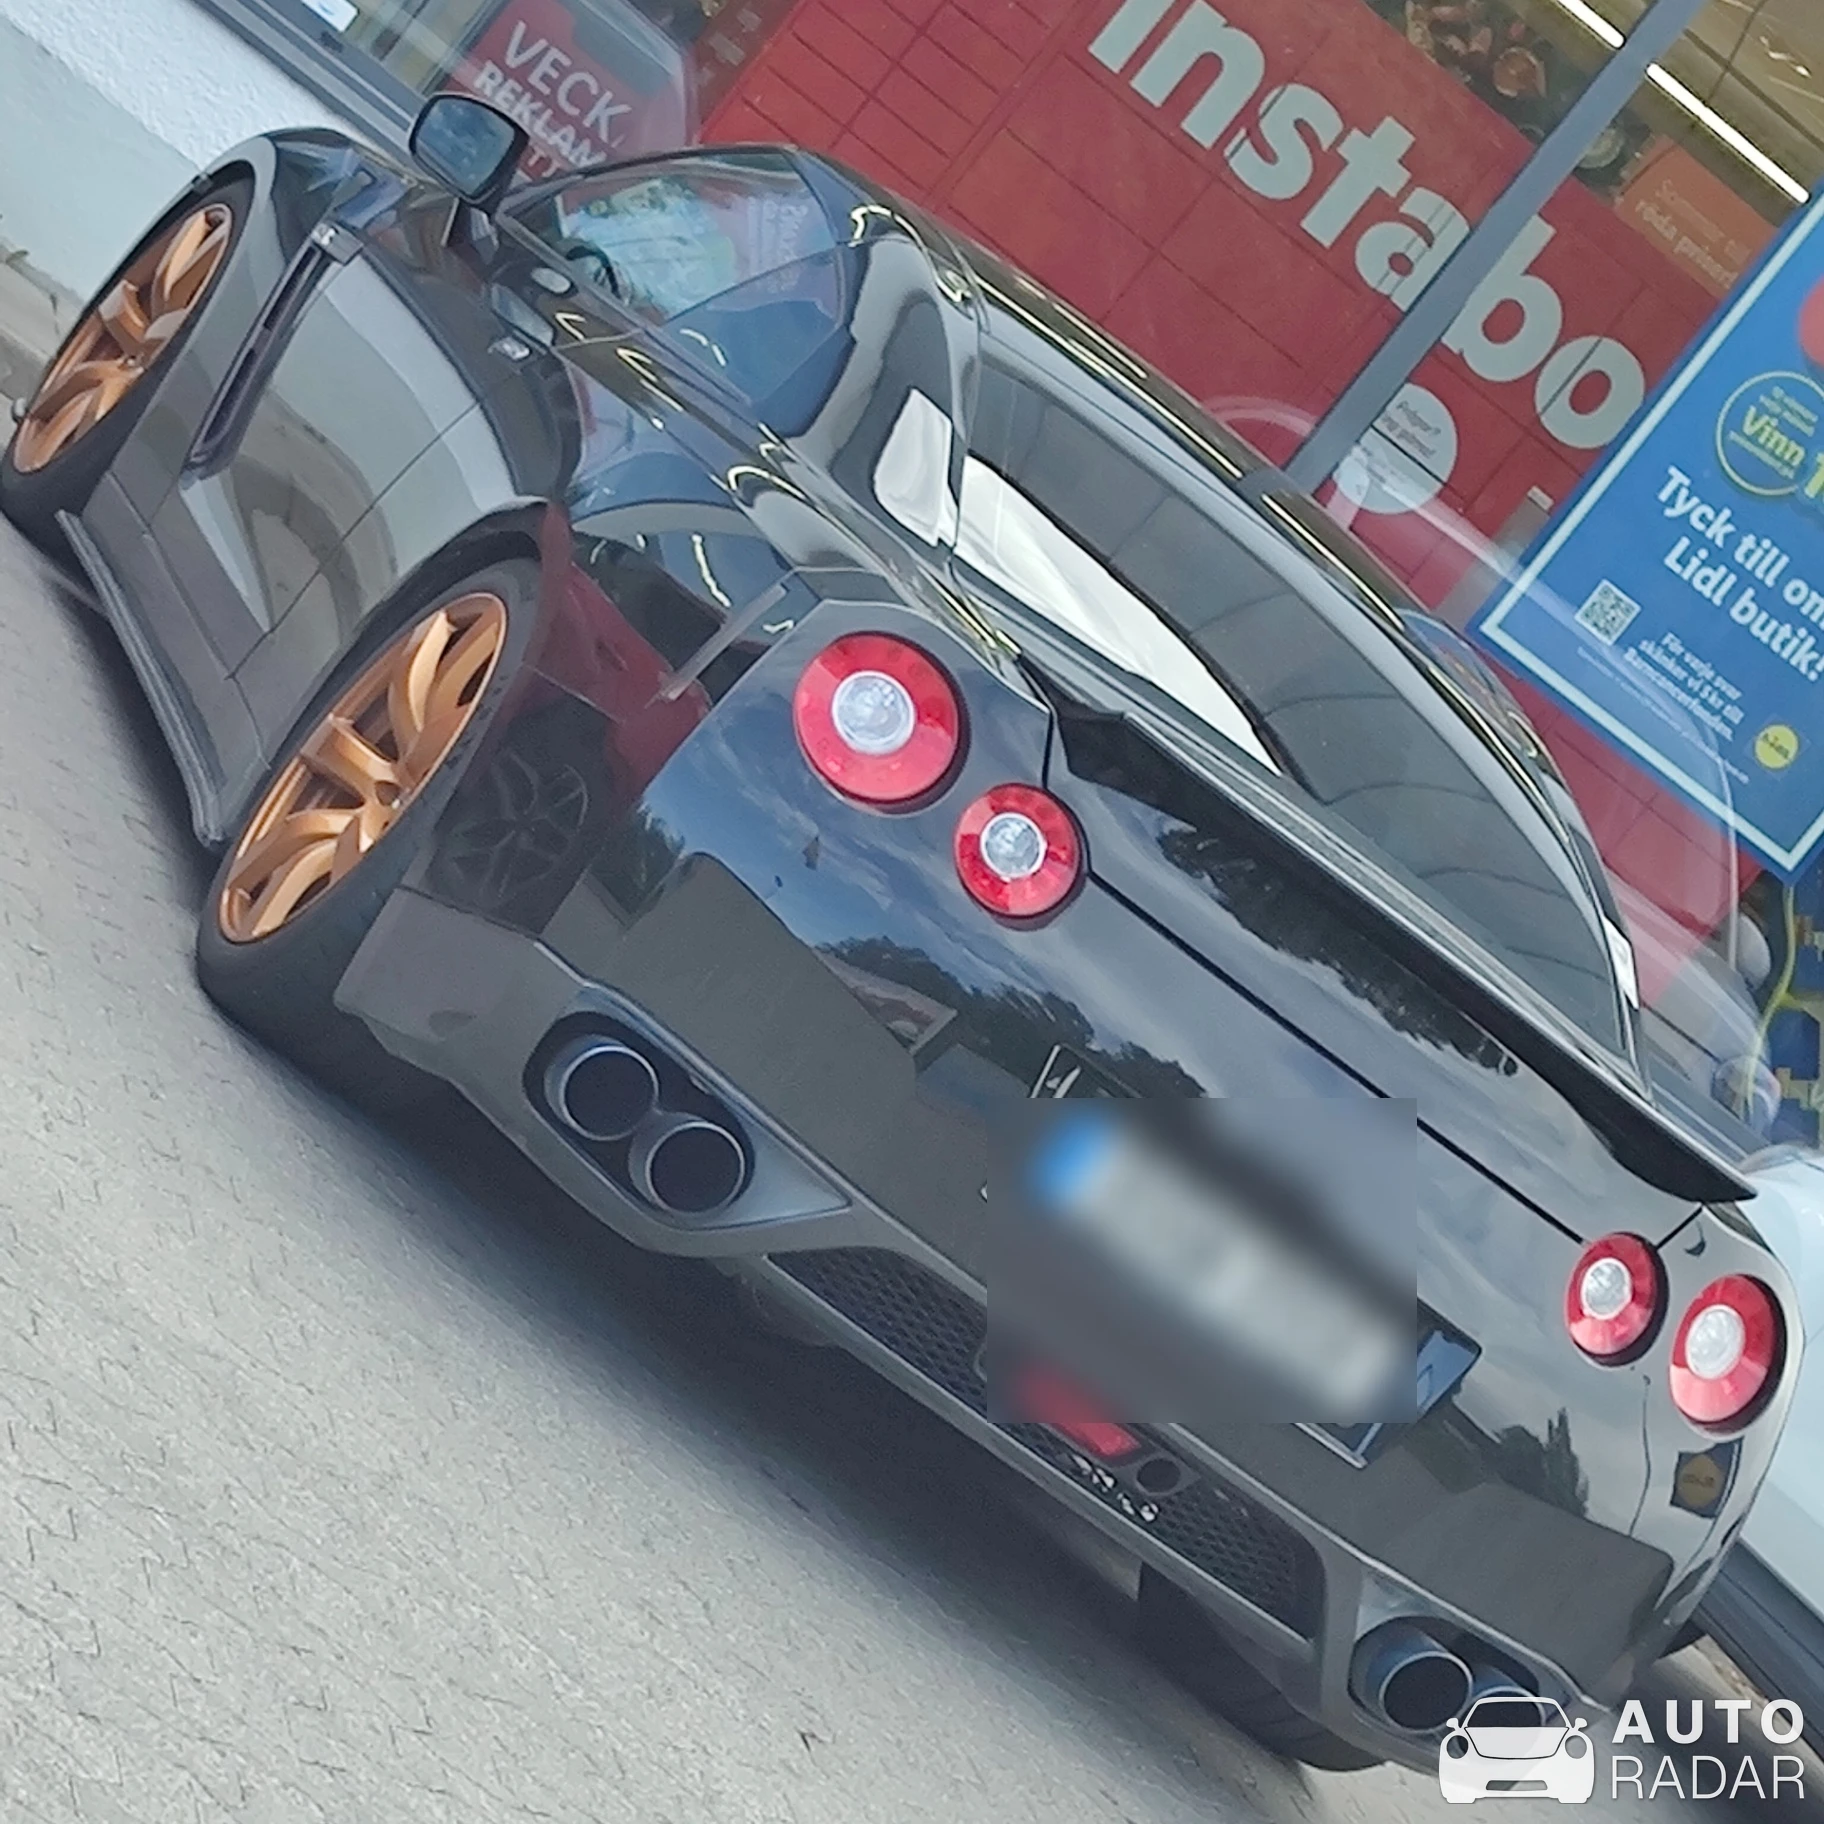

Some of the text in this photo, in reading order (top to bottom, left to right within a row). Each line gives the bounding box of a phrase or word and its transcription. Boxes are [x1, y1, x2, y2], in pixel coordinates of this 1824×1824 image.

[1742, 405, 1805, 467] Vinn
[1659, 465, 1735, 547] Tyck
[1735, 533, 1790, 588] till
[1665, 536, 1736, 606] Lidl
